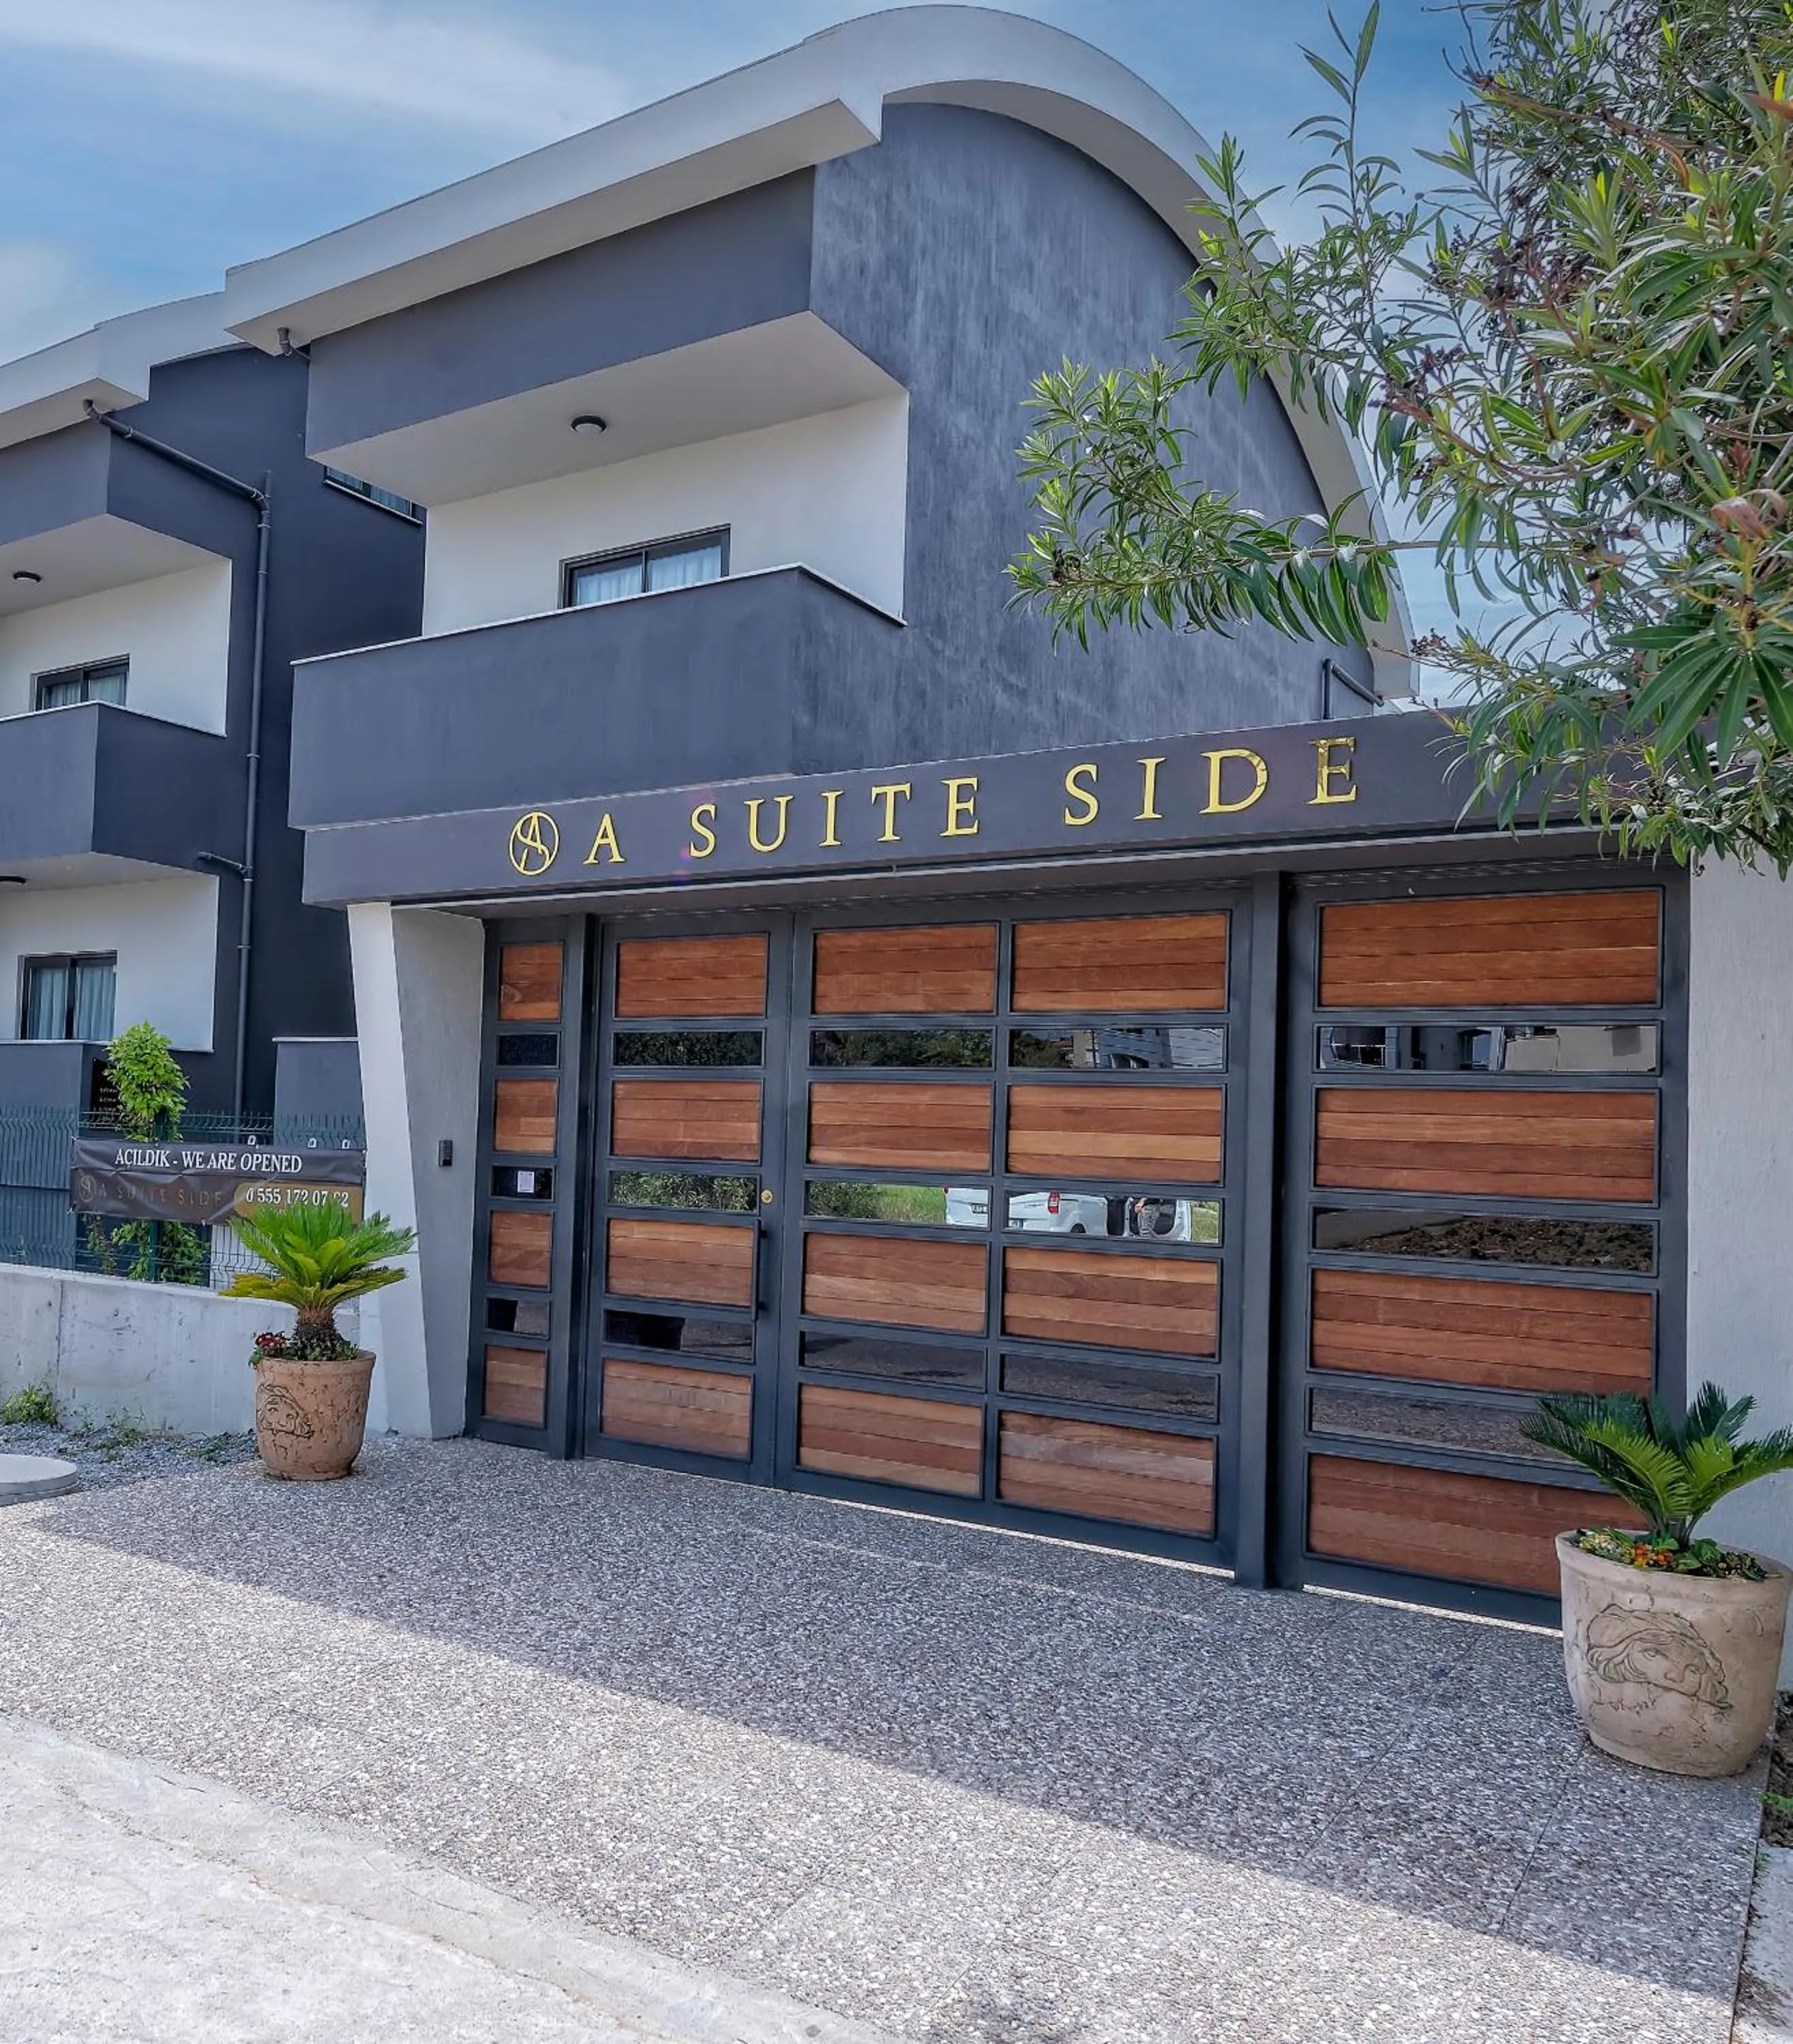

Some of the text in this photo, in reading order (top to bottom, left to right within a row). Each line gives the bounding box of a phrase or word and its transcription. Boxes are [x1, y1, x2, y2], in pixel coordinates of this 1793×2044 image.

[582, 736, 1358, 865] A SUITE SIDE
[182, 1151, 204, 1169] WE
[206, 1152, 237, 1171] ARE
[240, 1153, 302, 1173] OPENED
[246, 1188, 254, 1203] 0
[257, 1188, 281, 1204] 555
[285, 1189, 309, 1205] 172
[312, 1190, 329, 1206] 07
